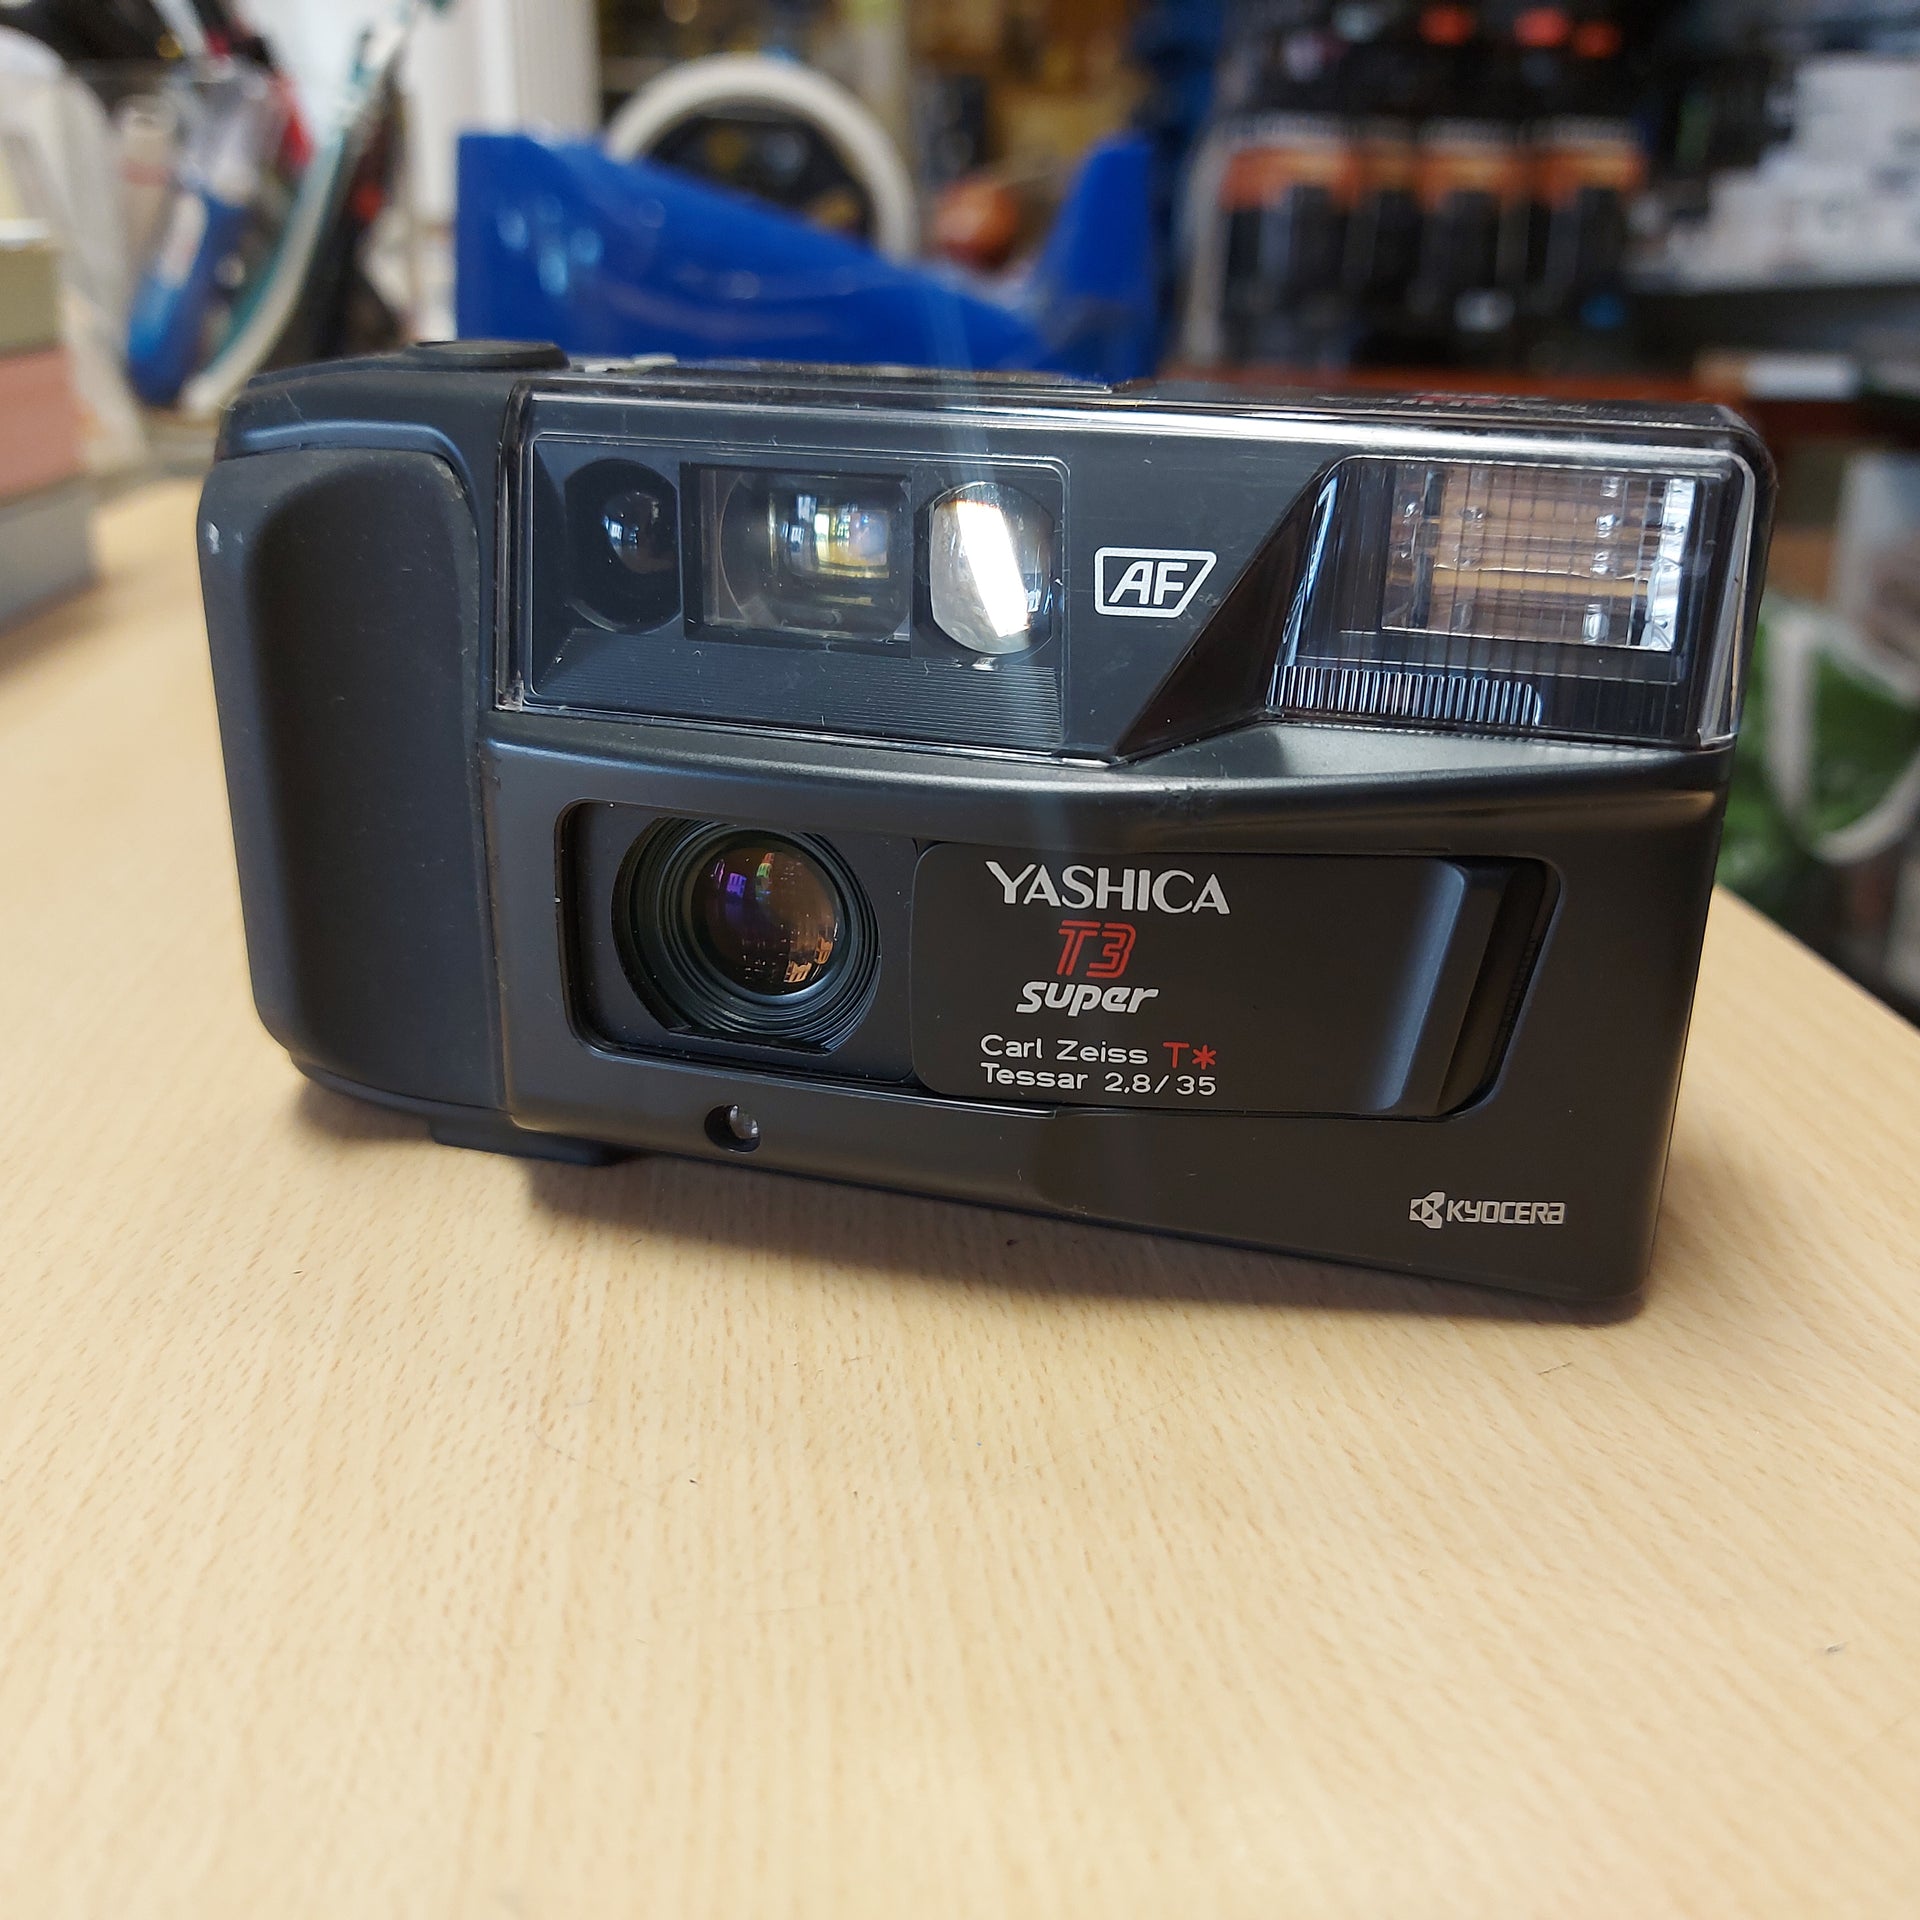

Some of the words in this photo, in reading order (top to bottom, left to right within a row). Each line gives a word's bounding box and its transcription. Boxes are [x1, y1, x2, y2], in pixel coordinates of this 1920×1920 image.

[1108, 561, 1188, 605] AF
[985, 861, 1231, 915] YASHICA
[1056, 919, 1137, 979] T3
[1015, 981, 1159, 1017] super
[980, 1034, 1043, 1059] Carl
[1056, 1039, 1148, 1064] Zeiss
[980, 1062, 1088, 1090] Tessar
[1446, 1200, 1566, 1225] KYOCERA
